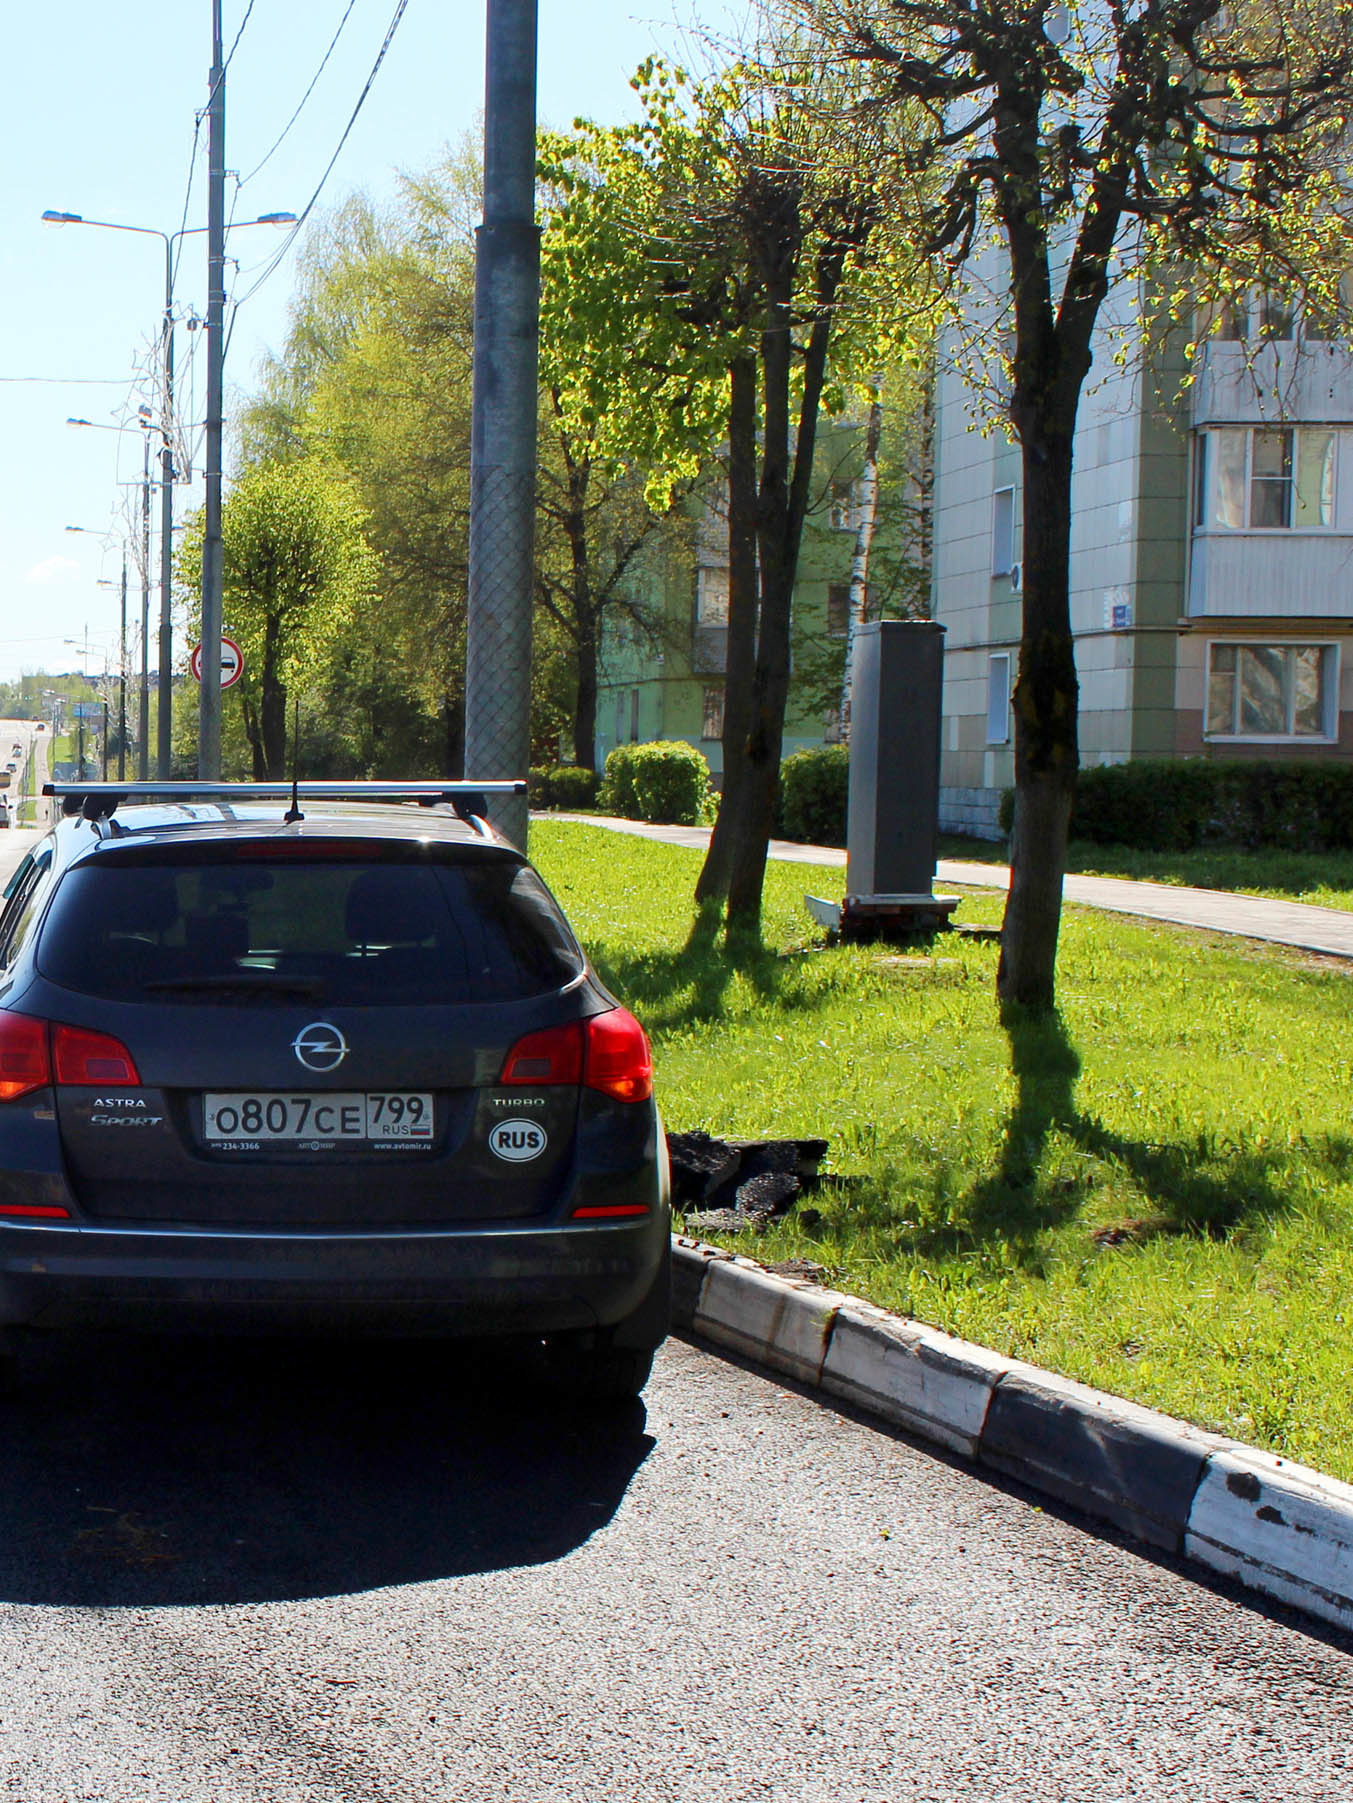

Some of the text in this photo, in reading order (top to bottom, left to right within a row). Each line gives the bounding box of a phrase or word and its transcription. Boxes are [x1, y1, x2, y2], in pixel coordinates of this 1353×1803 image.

[94, 1098, 147, 1108] ASTRA
[492, 1098, 545, 1107] TURBO
[368, 1096, 424, 1124] 799
[382, 1125, 410, 1135] RUS
[498, 1131, 540, 1149] RUS
[222, 1141, 260, 1150] 234-3366
[373, 1141, 432, 1151] www.avtomir.ru
